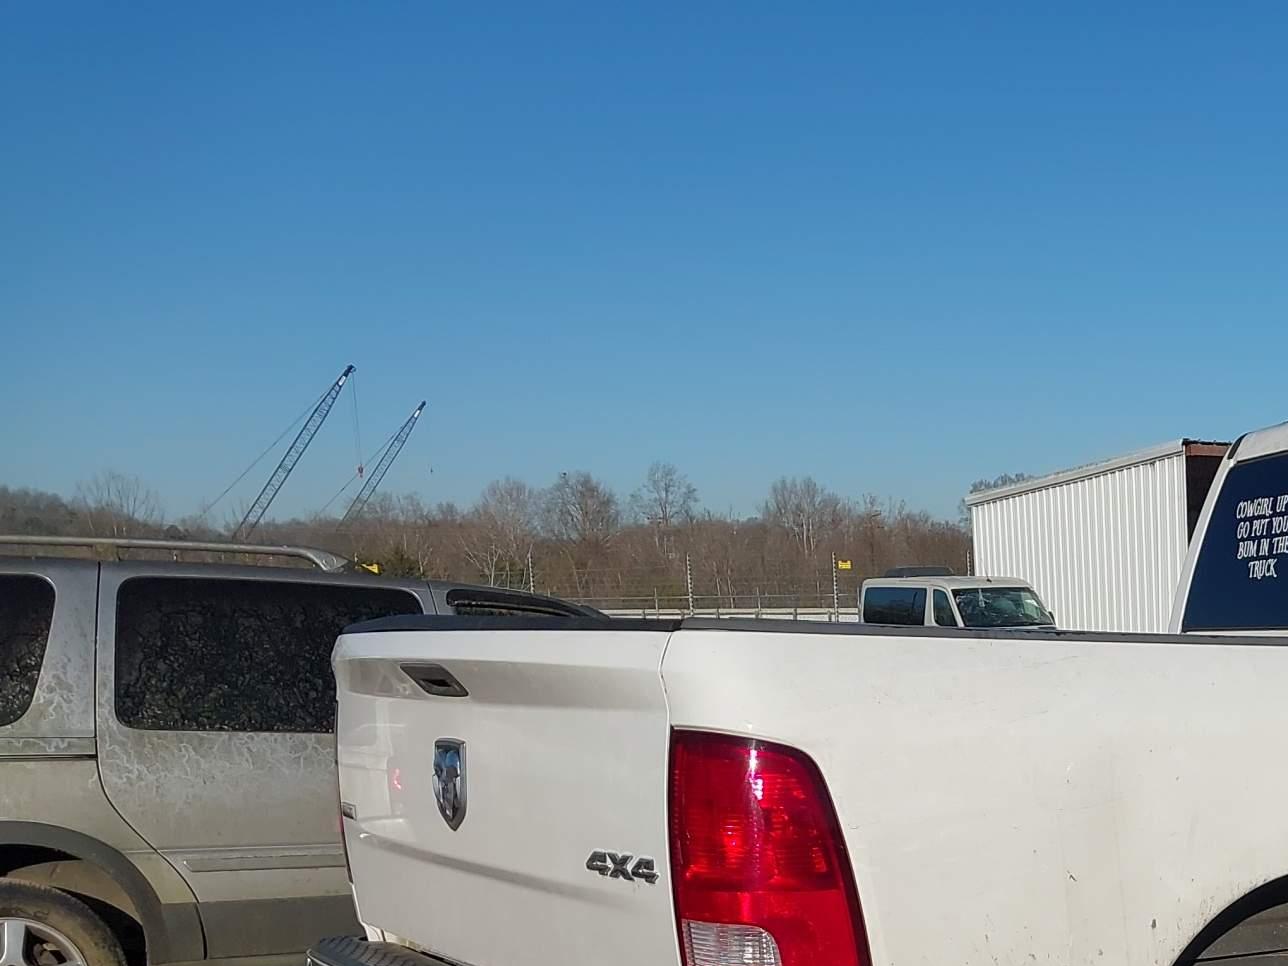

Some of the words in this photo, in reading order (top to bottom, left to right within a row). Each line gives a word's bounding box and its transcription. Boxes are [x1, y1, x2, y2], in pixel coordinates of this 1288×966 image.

[1236, 496, 1274, 519] COWGIRL
[1276, 494, 1288, 512] UP
[1237, 521, 1250, 539] GO
[1251, 518, 1271, 537] PUT
[1237, 539, 1258, 559] BUM
[1259, 538, 1271, 556] IN
[1248, 558, 1277, 580] TRUCK
[585, 850, 660, 884] 4X4
